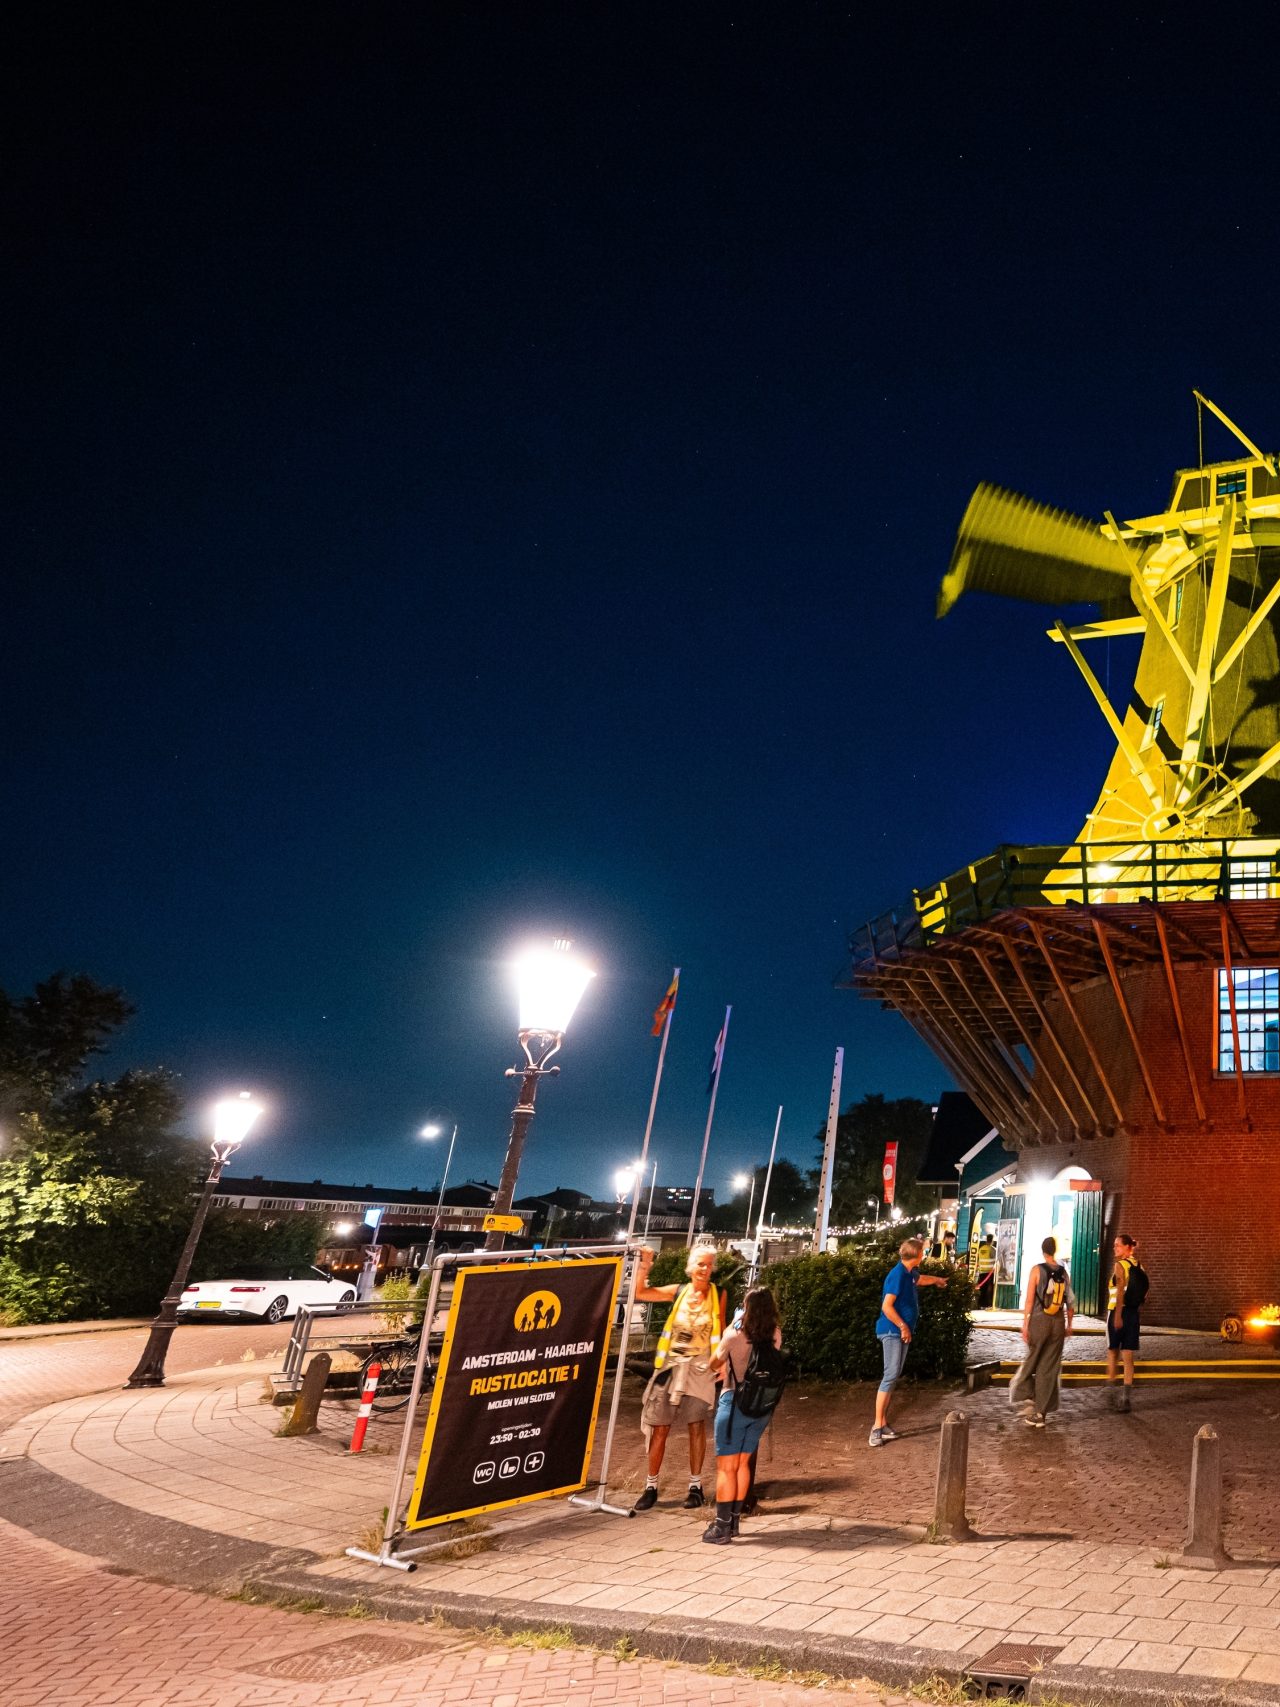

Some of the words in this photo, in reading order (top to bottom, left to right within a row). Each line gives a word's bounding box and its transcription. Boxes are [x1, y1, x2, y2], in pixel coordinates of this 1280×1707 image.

[461, 1348, 537, 1371] AMSTERDAM
[544, 1341, 595, 1359] HAARLEM
[469, 1365, 570, 1396] RUSTLOCATIE
[572, 1364, 580, 1380] 1
[487, 1399, 513, 1411] MOLEN
[513, 1396, 529, 1406] VAN
[529, 1391, 556, 1404] SLOTEN
[489, 1433, 513, 1445] 23:50
[518, 1427, 541, 1439] 02:30
[477, 1467, 493, 1479] WC
